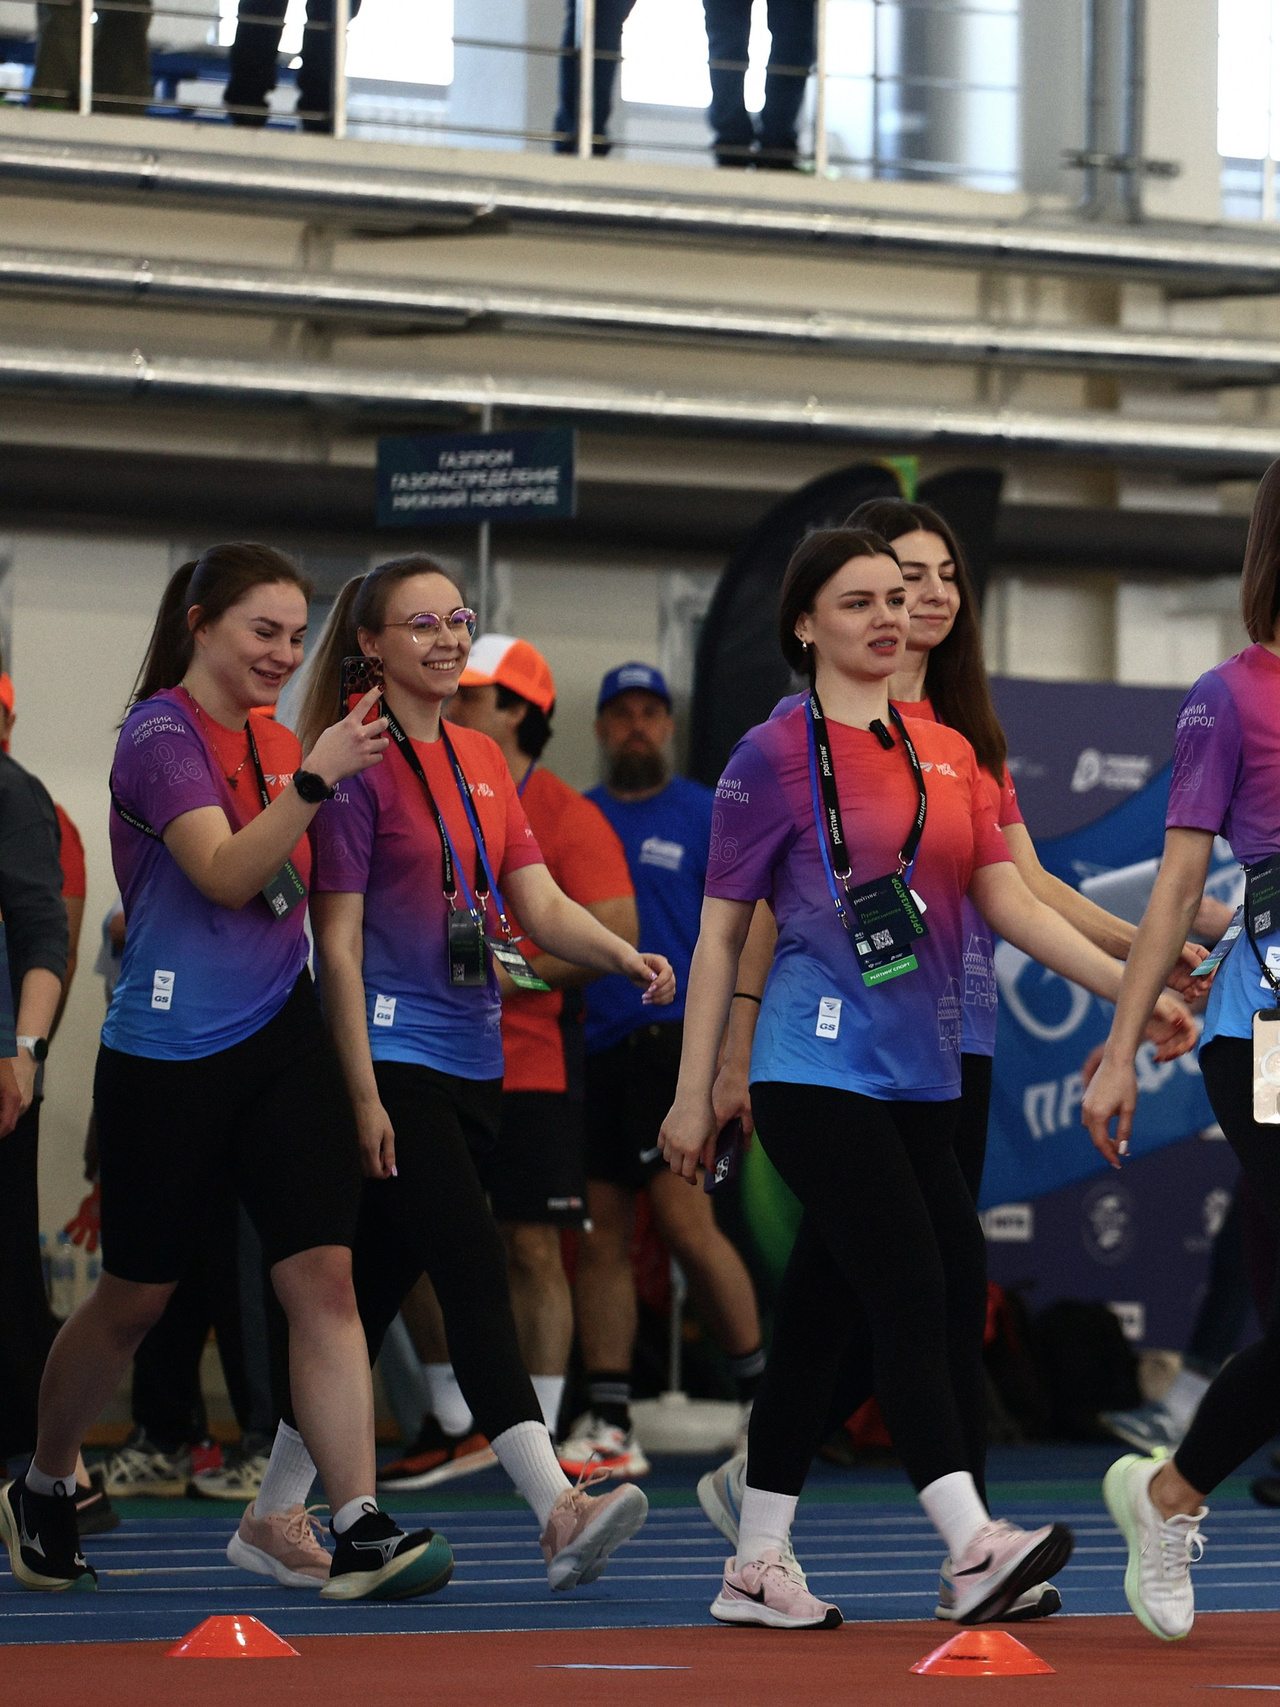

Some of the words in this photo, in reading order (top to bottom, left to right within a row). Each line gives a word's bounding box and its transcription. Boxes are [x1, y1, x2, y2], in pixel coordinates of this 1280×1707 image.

[438, 449, 514, 469] ГАЗПРОМ
[390, 466, 560, 491] ГАЗОРАСПРЕДЕЛЕНИЕ
[392, 489, 468, 511] НИЖНИЙ
[469, 485, 558, 508] НОВГОРОД
[131, 715, 173, 739] НИЖНИЙ
[134, 724, 186, 747] НОВГОРОД
[820, 744, 833, 777] рейтинг
[913, 792, 926, 829] рейтинг
[829, 807, 843, 845] рейтинг
[284, 861, 304, 895] ОРГАНИ
[891, 877, 924, 934] ОРГАНИЗАТОР
[154, 995, 169, 1003] GS
[376, 1012, 392, 1020] GS
[819, 1022, 836, 1031] GS
